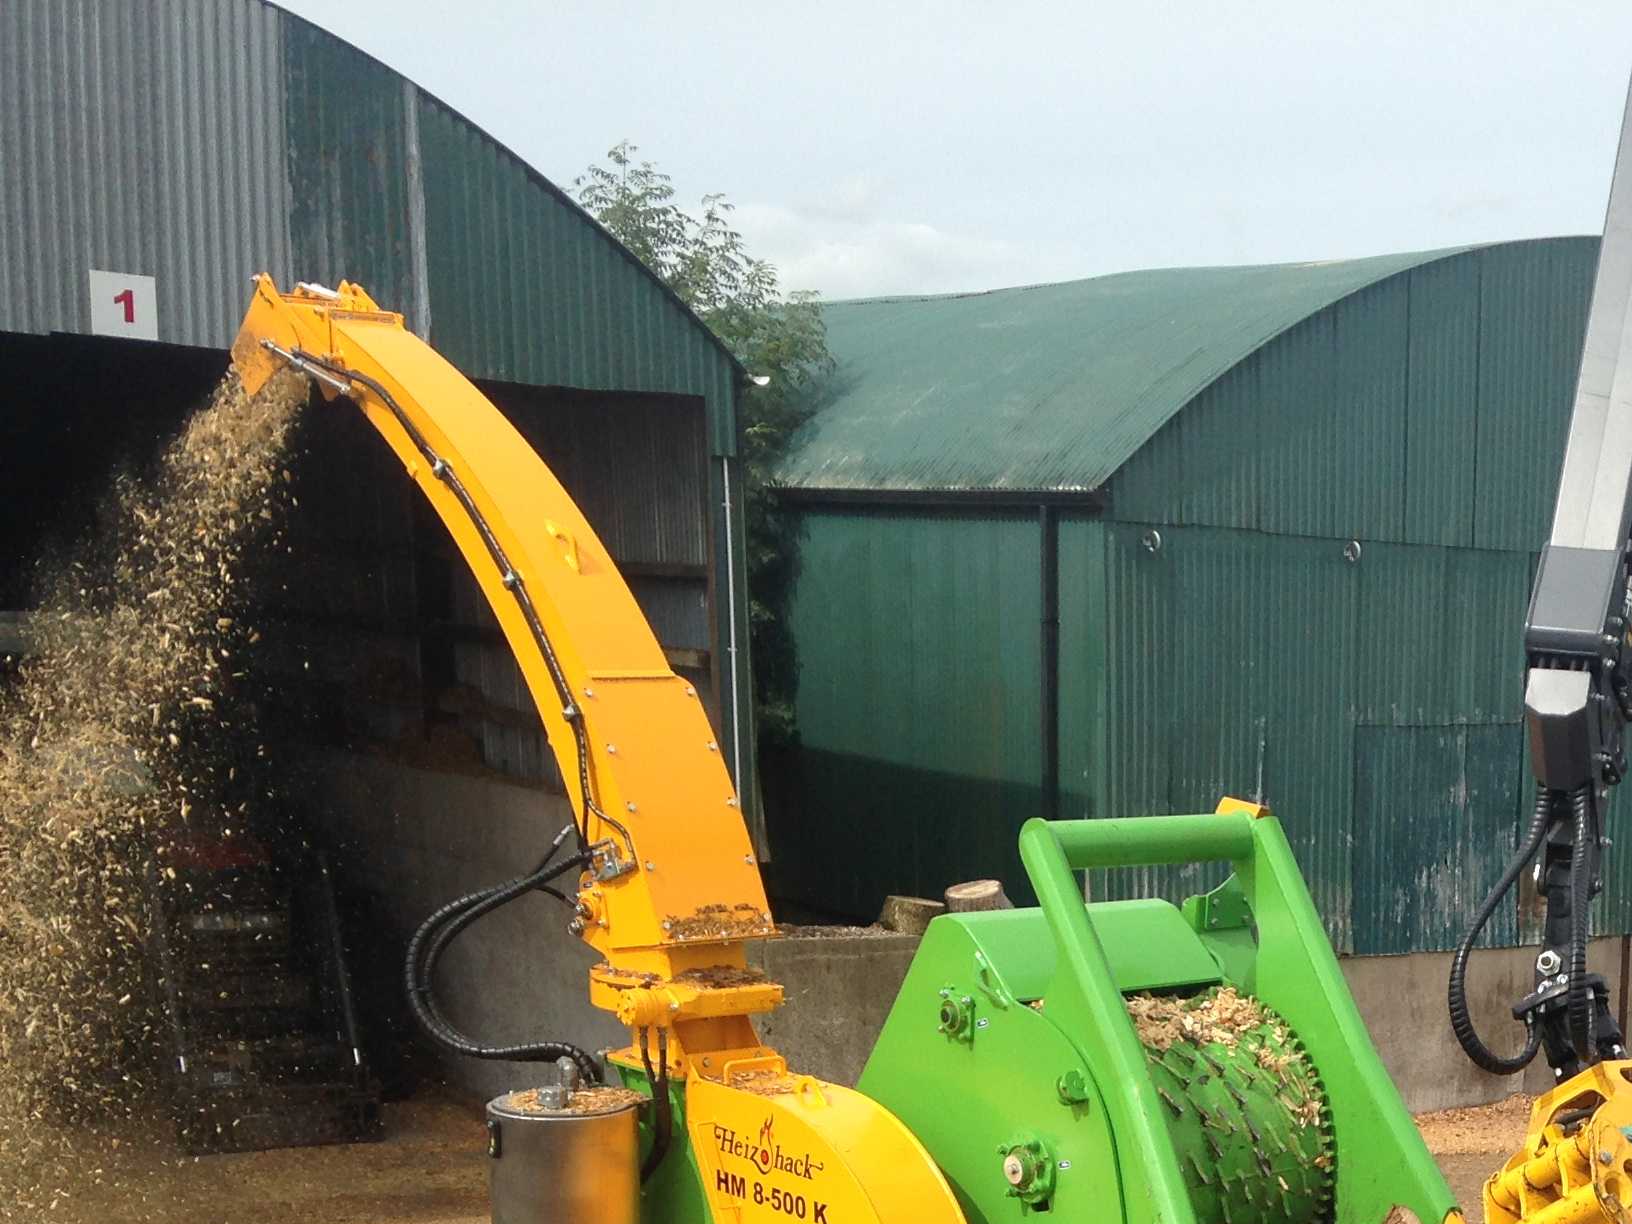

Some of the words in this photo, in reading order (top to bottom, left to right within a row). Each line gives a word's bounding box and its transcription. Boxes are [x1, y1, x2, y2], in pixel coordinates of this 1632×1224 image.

[114, 289, 135, 323] 1
[716, 1168, 747, 1200] HM
[753, 1181, 807, 1220] 8-500
